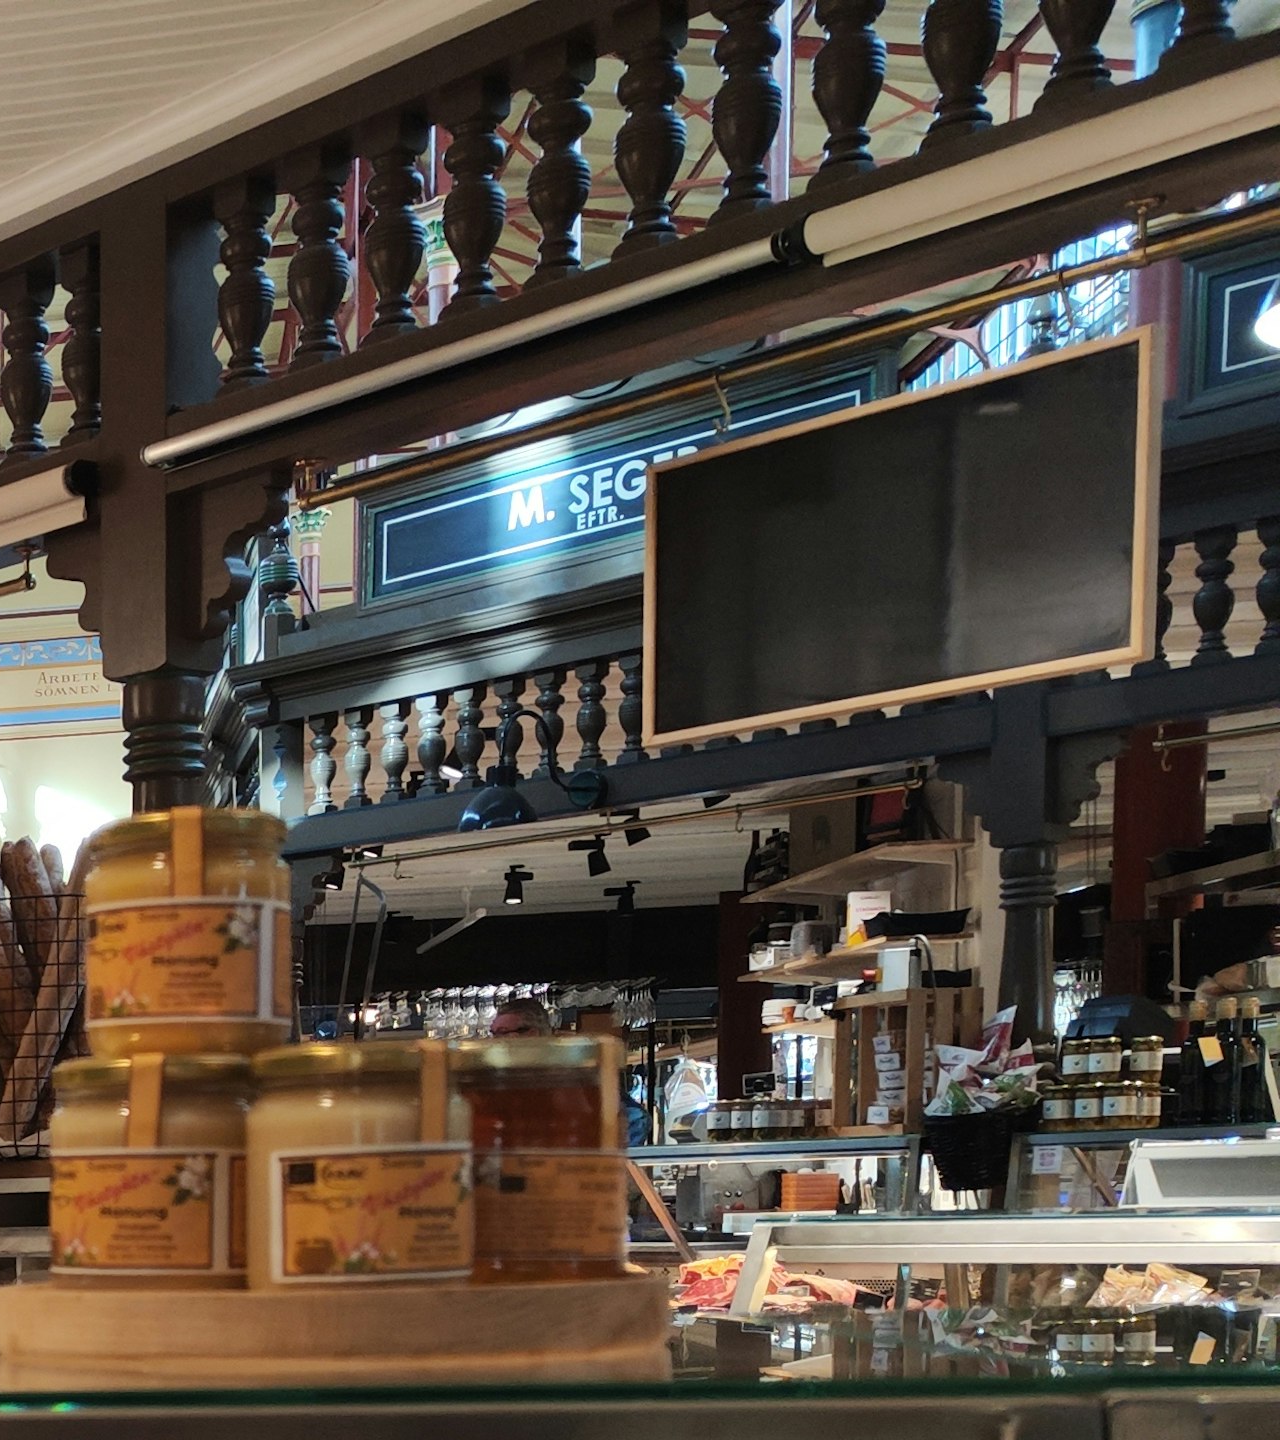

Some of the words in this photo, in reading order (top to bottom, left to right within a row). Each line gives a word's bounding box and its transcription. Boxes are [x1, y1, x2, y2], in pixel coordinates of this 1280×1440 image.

[507, 485, 556, 531] M.
[568, 446, 698, 515] SEG
[576, 505, 624, 531] EFTR.
